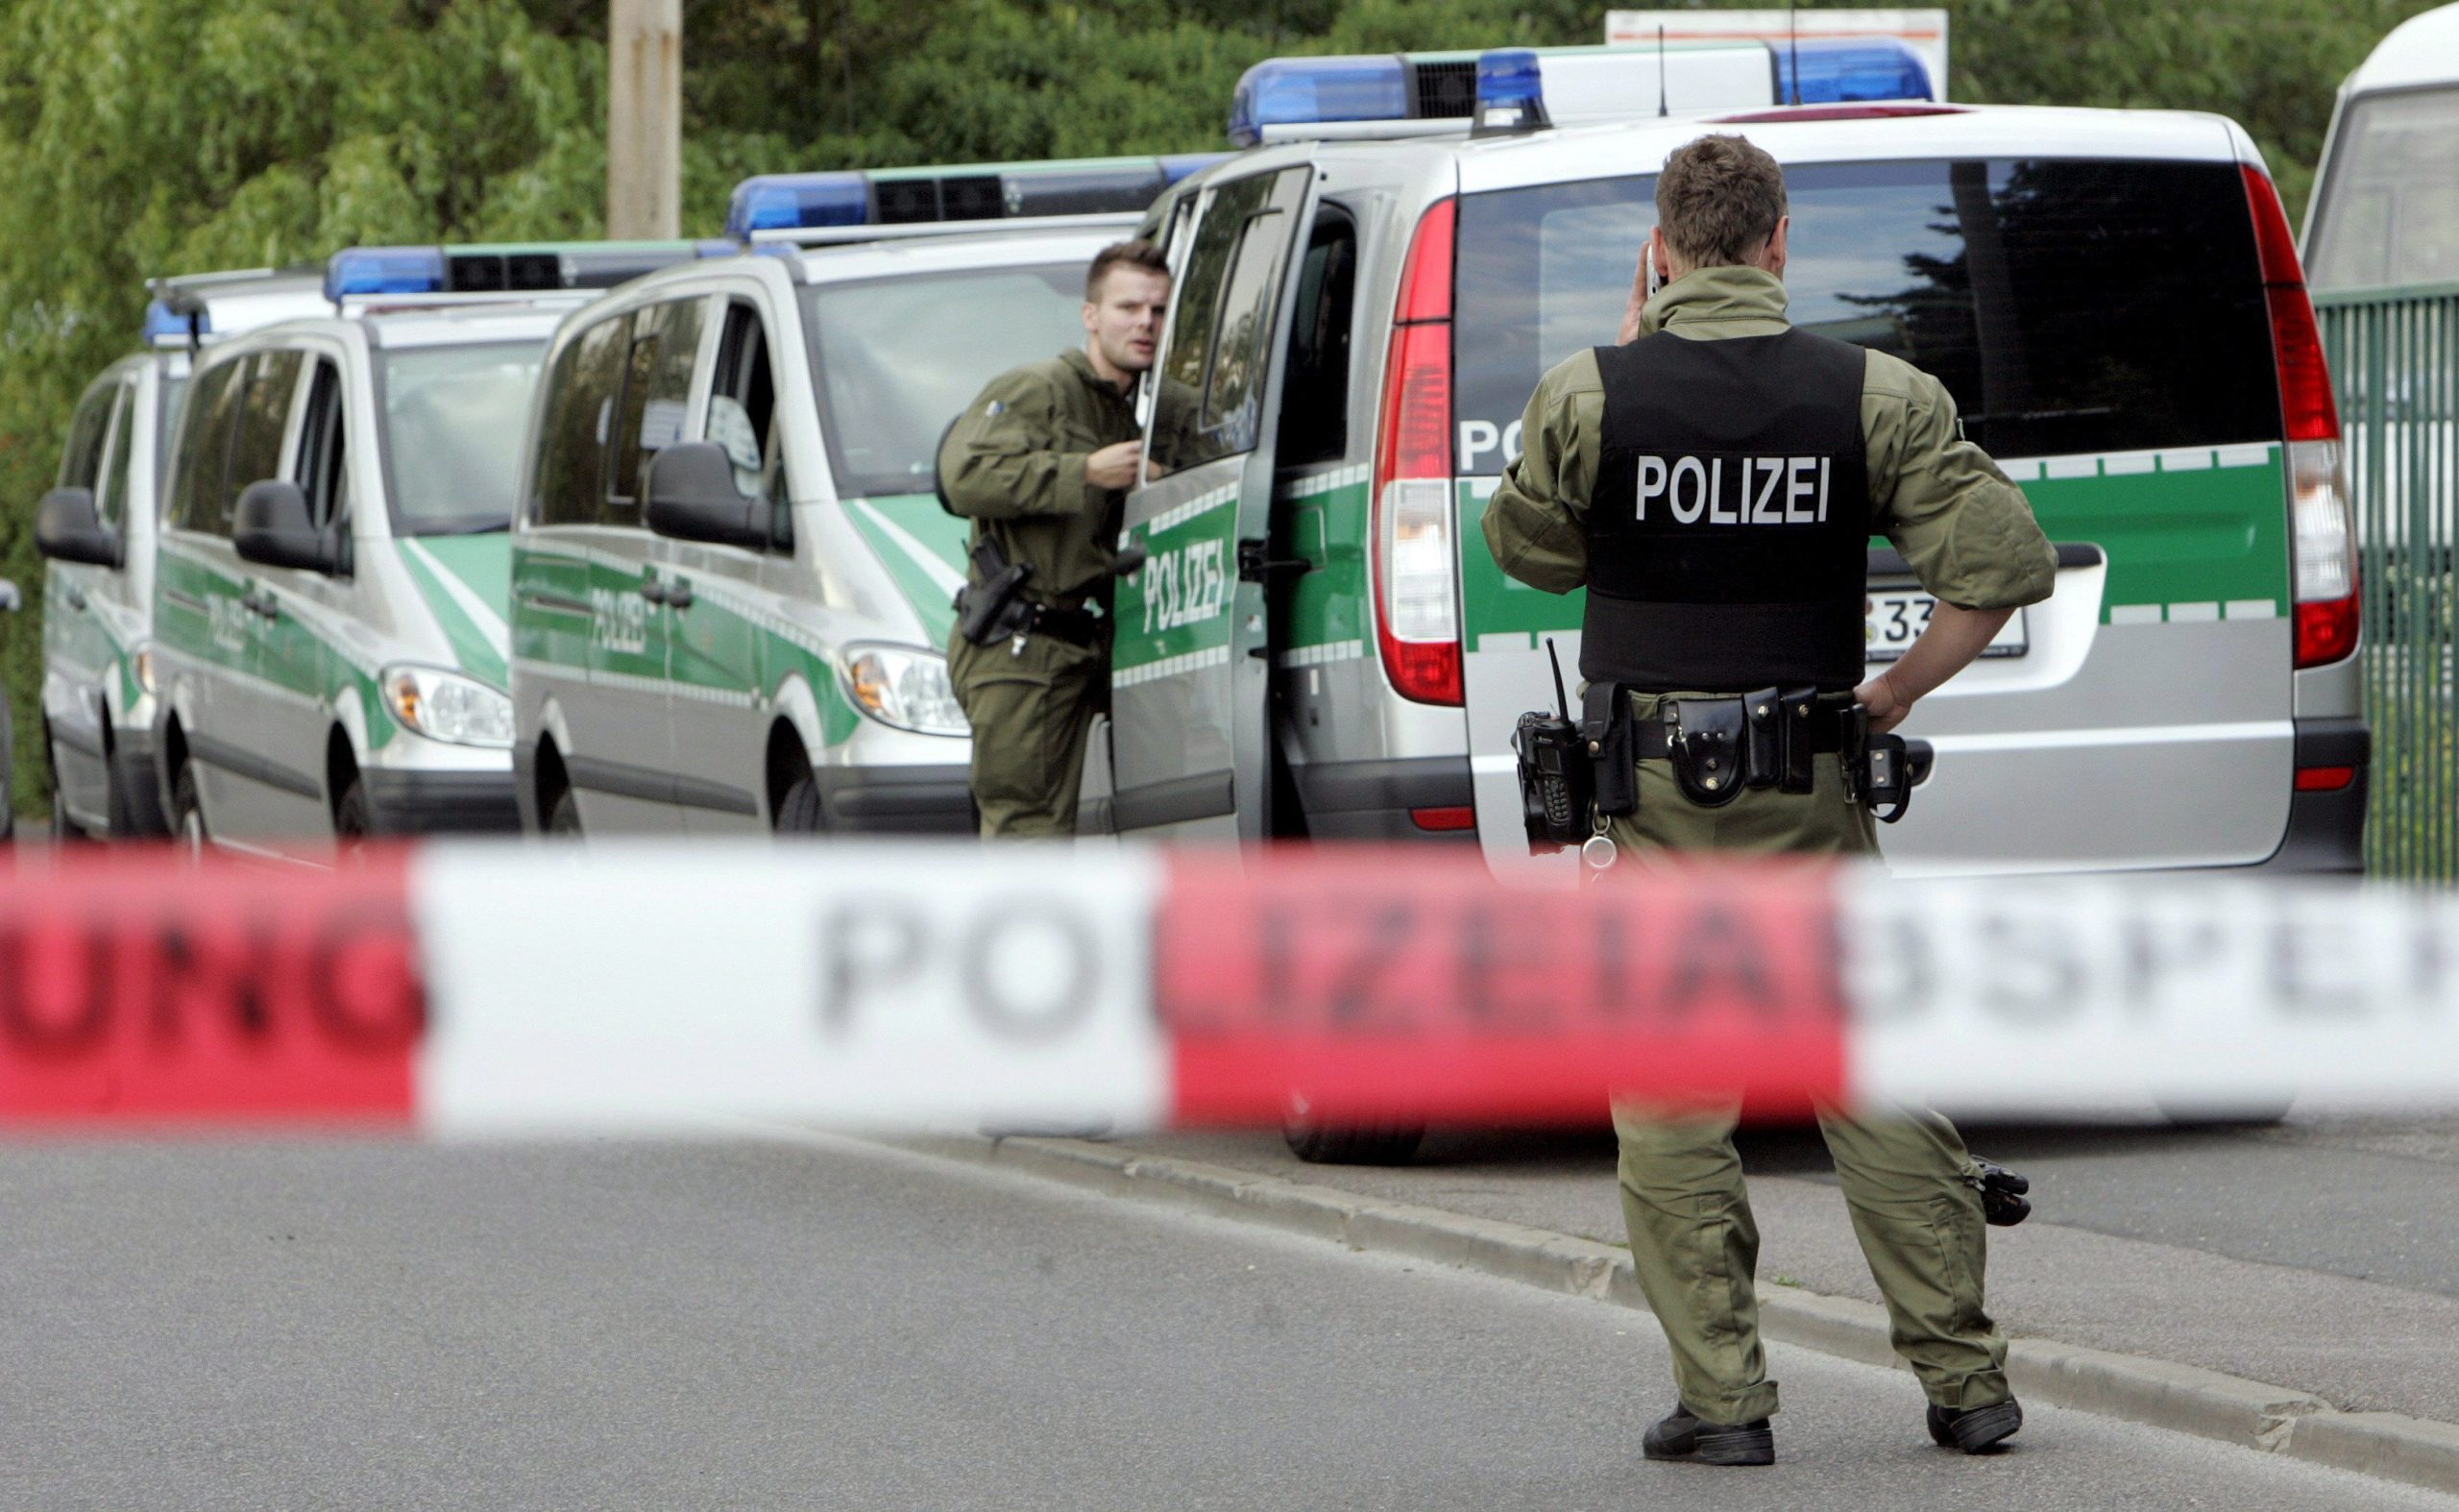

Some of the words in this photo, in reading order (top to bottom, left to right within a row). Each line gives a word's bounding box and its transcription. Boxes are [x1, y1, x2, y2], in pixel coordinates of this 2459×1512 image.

[1636, 455, 1831, 524] POLIZEI
[1143, 537, 1225, 635] POLIZEI
[0, 903, 442, 1062] UNG
